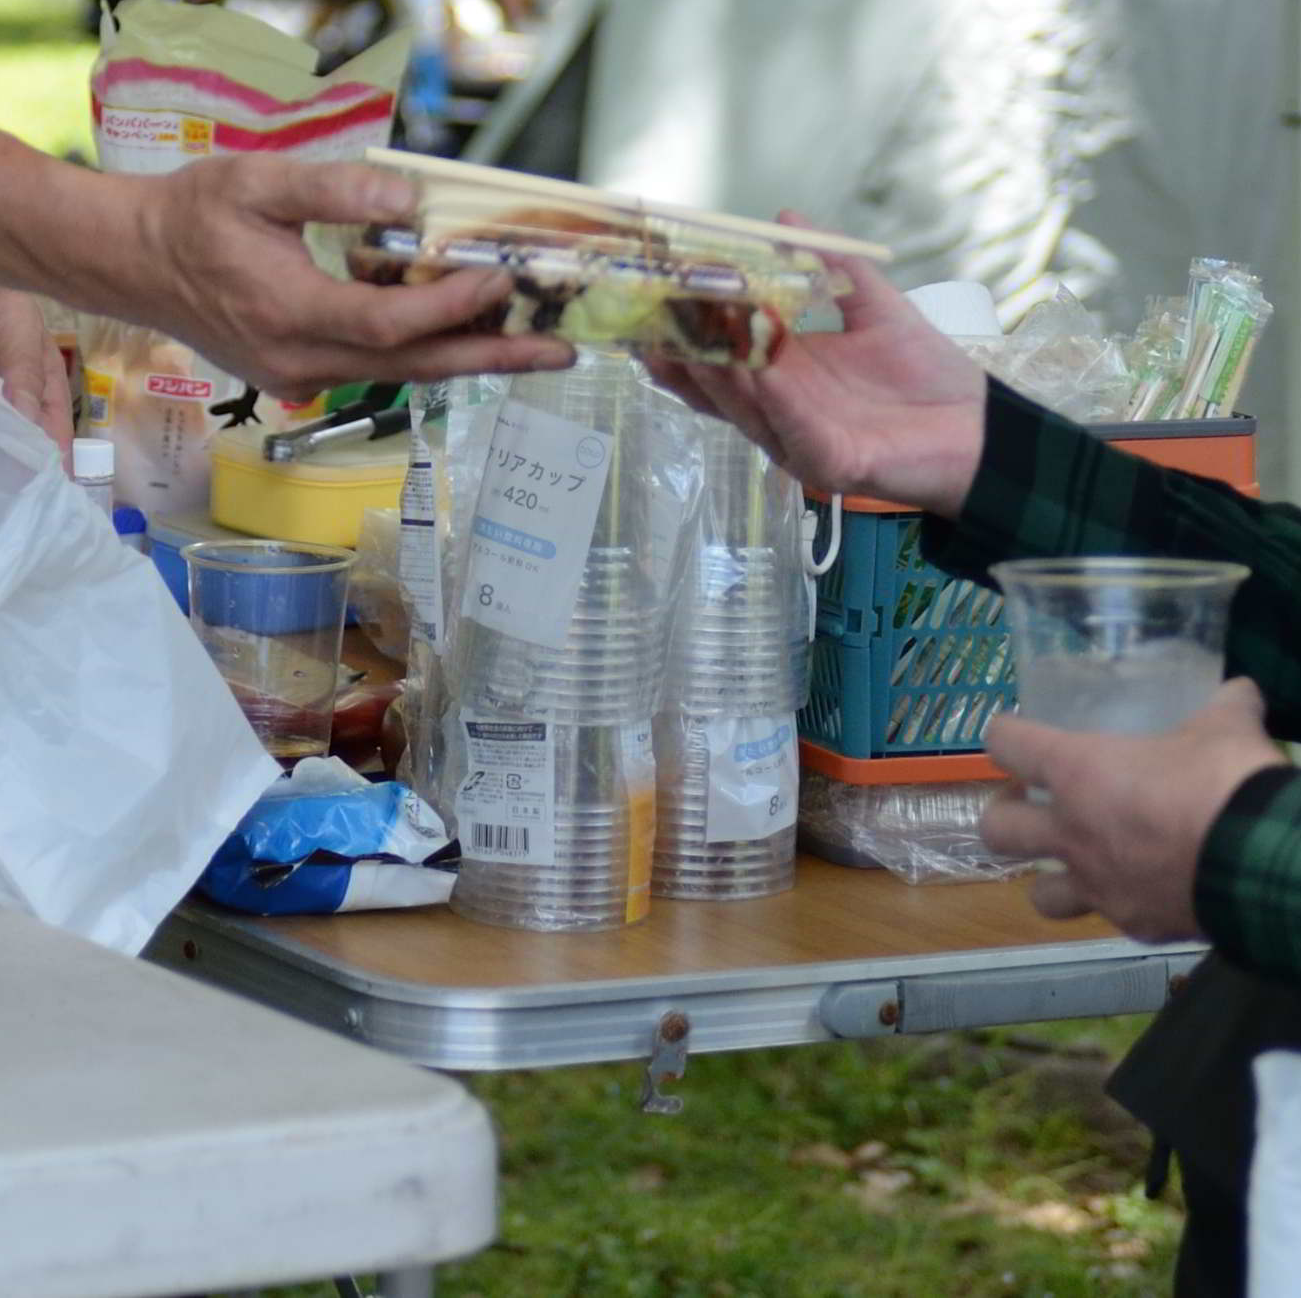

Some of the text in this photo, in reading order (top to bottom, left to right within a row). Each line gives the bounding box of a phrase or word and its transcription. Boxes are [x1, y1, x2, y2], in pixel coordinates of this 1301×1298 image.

[151, 377, 209, 396] フジパン
[503, 486, 539, 510] 420
[479, 584, 494, 607] 8
[769, 795, 780, 816] 8
